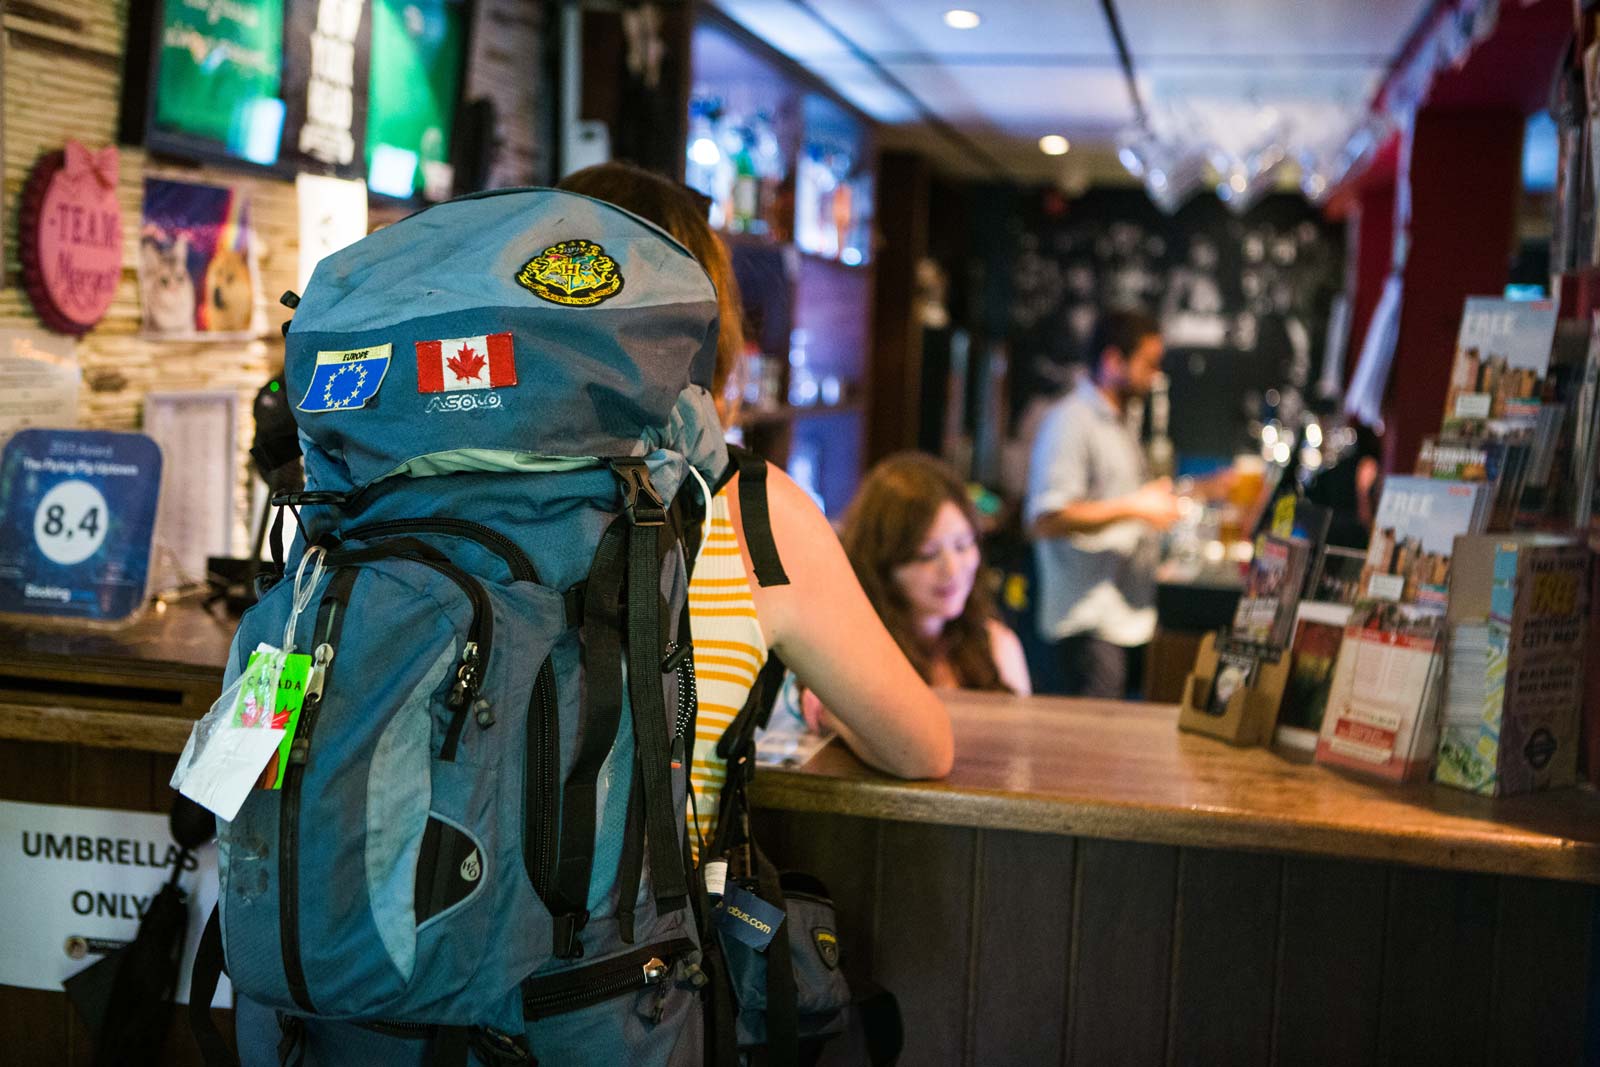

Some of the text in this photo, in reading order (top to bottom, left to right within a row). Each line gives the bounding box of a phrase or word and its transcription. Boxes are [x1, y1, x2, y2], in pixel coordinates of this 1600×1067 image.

[57, 202, 118, 248] TEAM
[343, 350, 369, 361] EUROPE
[425, 392, 505, 413] ASOLO
[23, 457, 42, 470] The
[42, 458, 75, 475] Flying
[75, 460, 95, 476] Pig
[43, 504, 100, 541] 8,4
[21, 831, 200, 872] UMBRELLAS
[72, 889, 150, 920] ONLY
